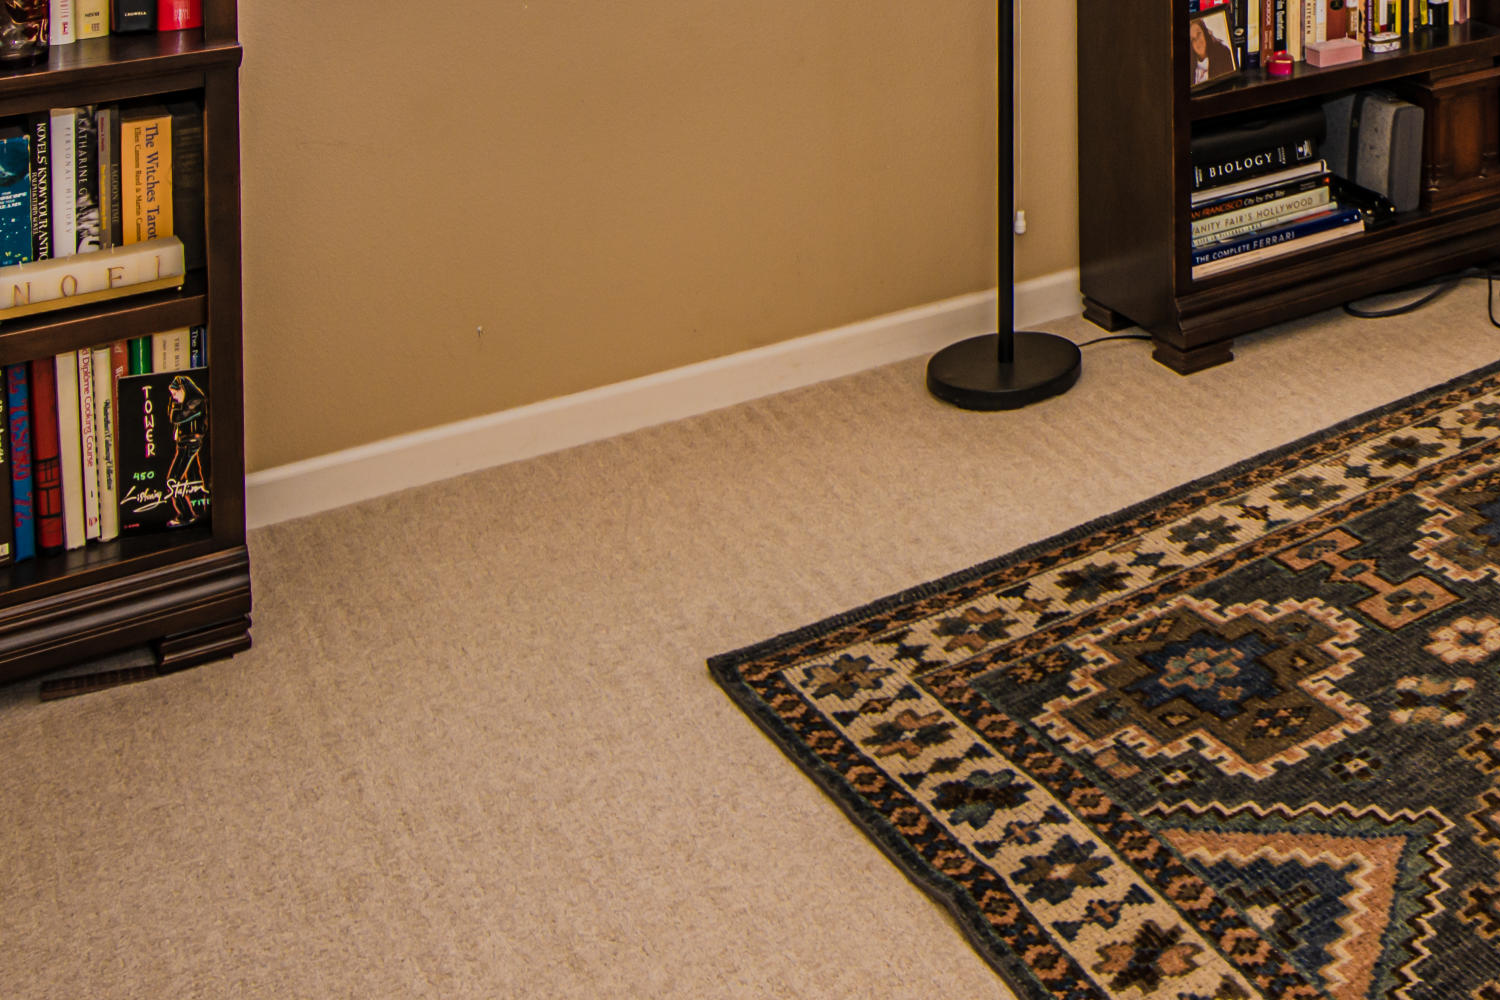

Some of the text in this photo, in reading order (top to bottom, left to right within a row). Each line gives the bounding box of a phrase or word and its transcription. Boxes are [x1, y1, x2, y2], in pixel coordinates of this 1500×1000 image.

[36, 122, 48, 165] KOVELS'
[134, 127, 142, 143] Ellen
[77, 118, 88, 186] KATHARINE
[1208, 152, 1273, 178] BIOLOGY
[37, 167, 48, 199] KNOW
[64, 127, 72, 234] PERSONAL HISTORY
[111, 163, 120, 224] LAGOON TIME
[145, 123, 160, 240] The Witches Tarot
[37, 199, 48, 229] YOUR
[1224, 214, 1253, 229] FAIR'S
[1255, 196, 1314, 218] HOLLYWOOD
[1195, 254, 1210, 264] THE
[1212, 243, 1251, 259] COMPLETE
[1252, 230, 1296, 249] FERRARI
[191, 330, 199, 348] The
[83, 395, 93, 434] Cooking
[142, 384, 156, 458] TOWER
[86, 435, 94, 467] Course
[133, 471, 155, 481] 450
